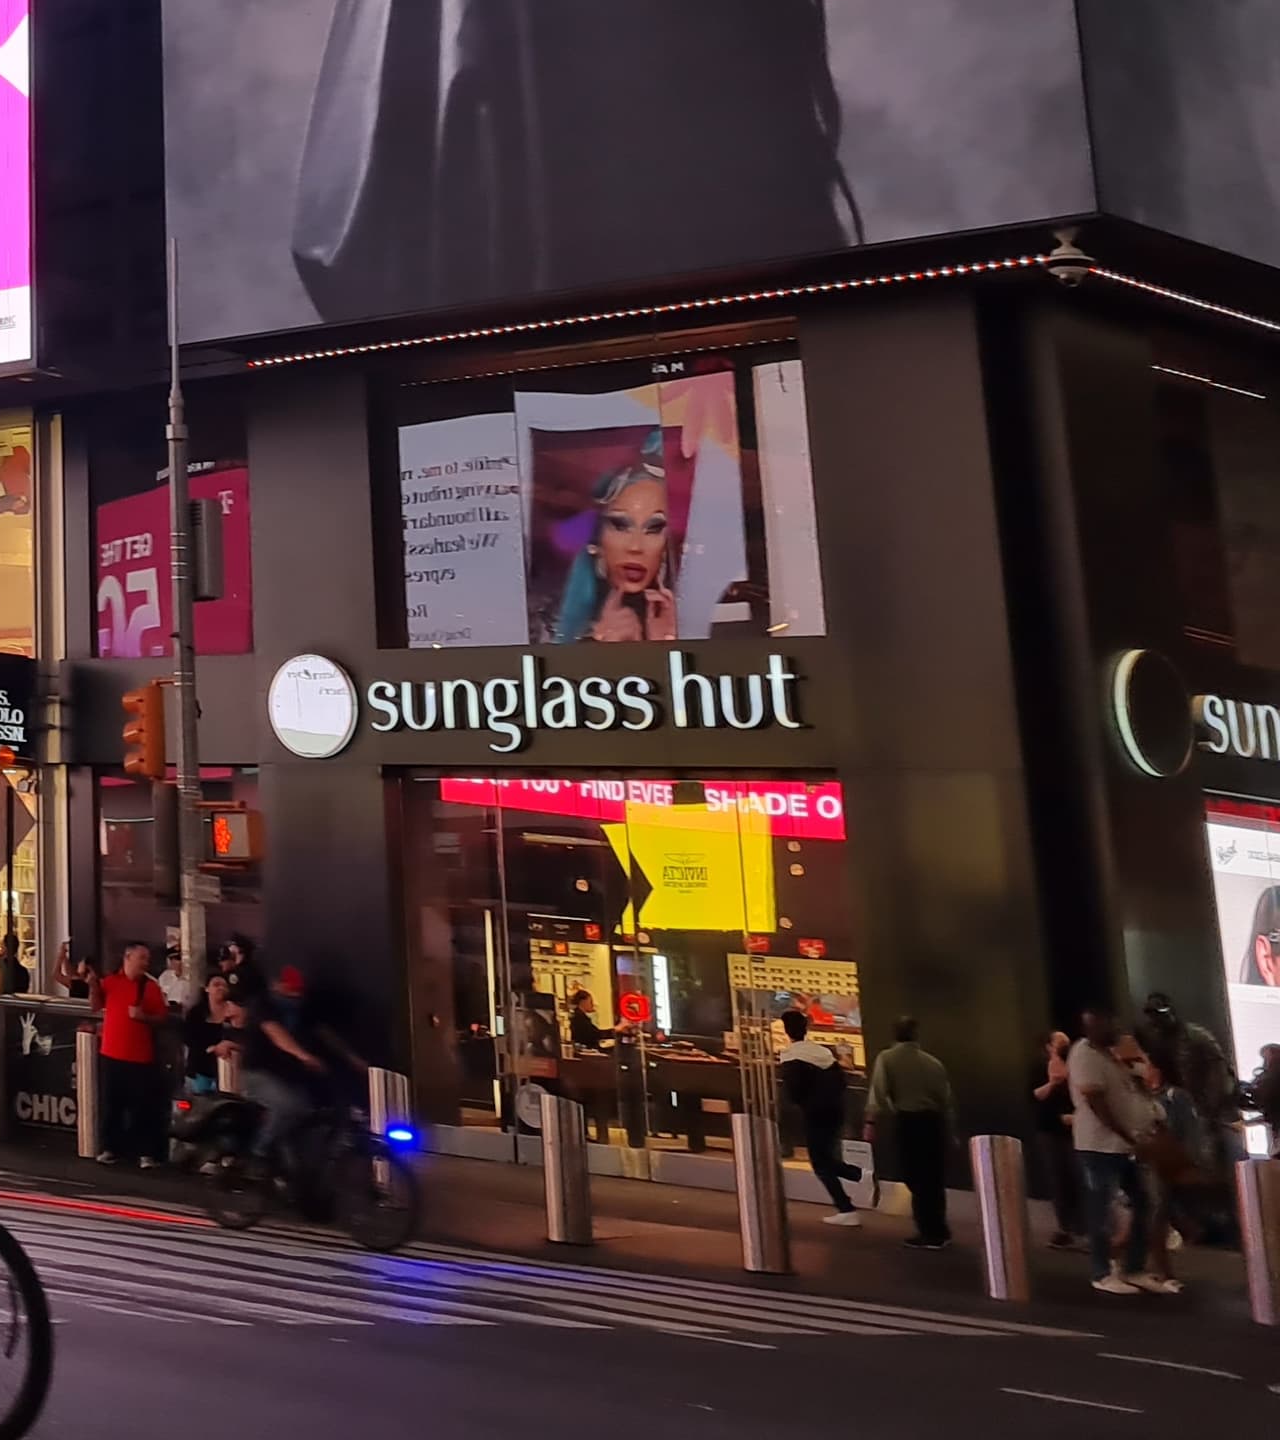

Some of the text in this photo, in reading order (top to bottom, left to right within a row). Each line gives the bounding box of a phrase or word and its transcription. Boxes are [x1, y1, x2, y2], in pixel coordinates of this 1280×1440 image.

[366, 650, 802, 754] sunglass hut
[580, 779, 626, 802] FIND
[704, 788, 809, 818] SHADE
